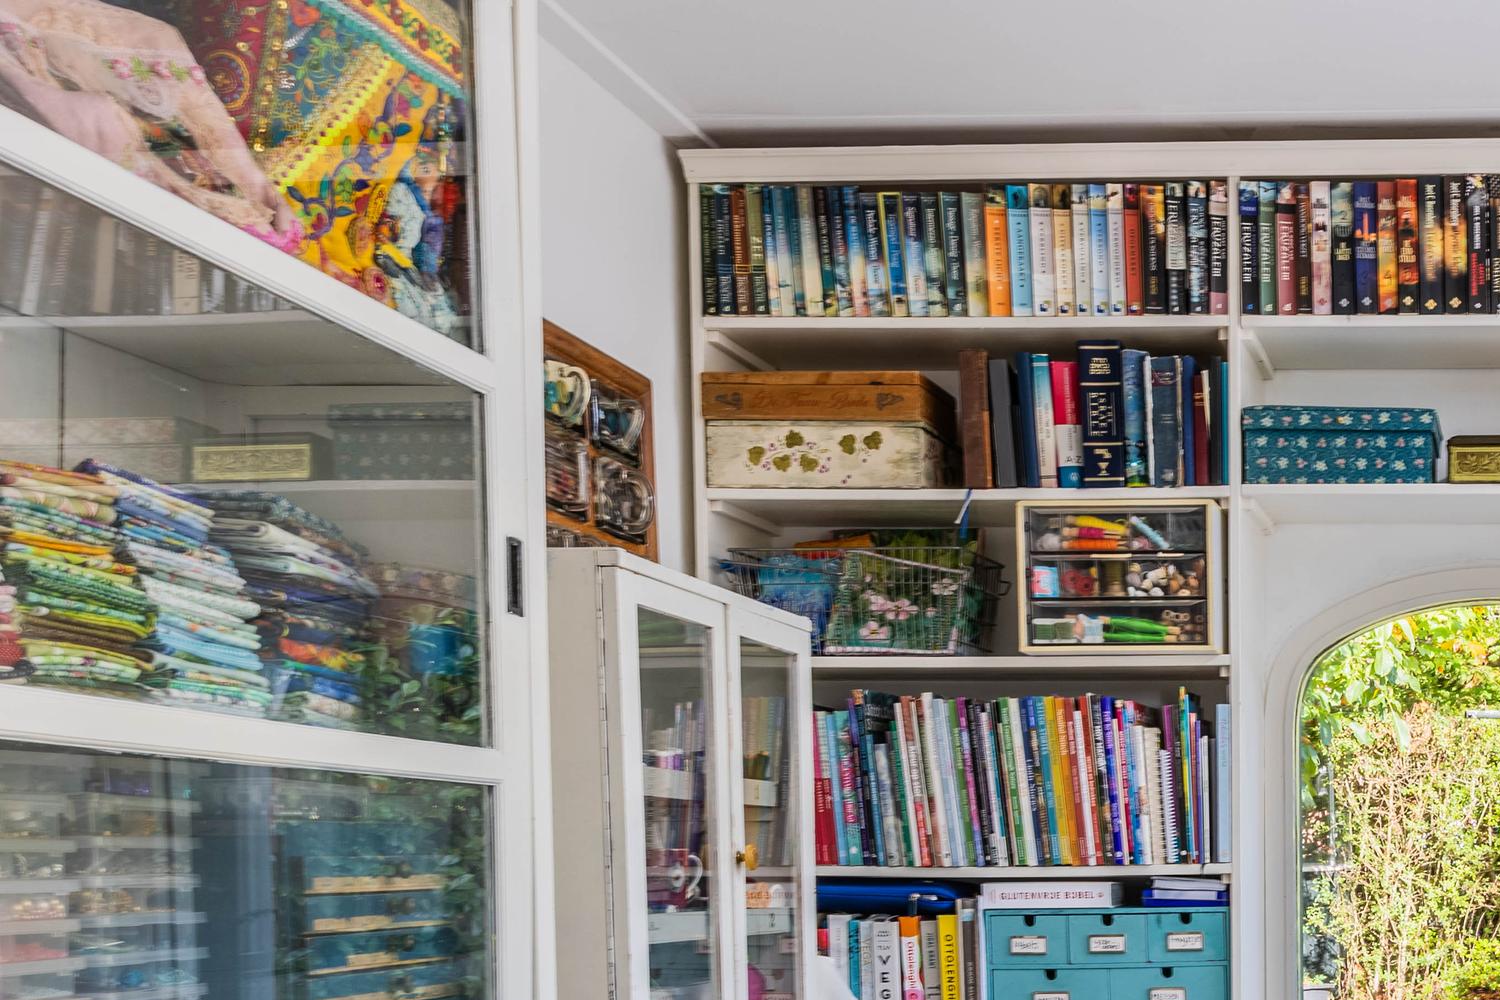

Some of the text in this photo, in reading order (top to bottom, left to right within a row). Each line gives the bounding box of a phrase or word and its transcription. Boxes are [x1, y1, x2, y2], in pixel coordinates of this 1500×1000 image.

[1425, 184, 1436, 195] Joel
[945, 207, 958, 231] Passage
[1424, 201, 1435, 228] Rosenberg
[752, 236, 763, 260] ZEE
[947, 235, 960, 257] Danzig
[1016, 228, 1026, 282] AANGERAAKT
[1211, 217, 1222, 277] JERUZALEM
[1241, 223, 1253, 283] JERUZALEM
[1260, 223, 1272, 283] JERUZALEM
[1279, 221, 1291, 281] JERUZALEM
[1089, 392, 1099, 437] BIBLE
[1098, 392, 1108, 436] ISRAEL
[1103, 711, 1112, 722] Felt
[908, 745, 921, 768] kleur
[862, 937, 872, 967] VEGA
[907, 942, 917, 989] Ottolenghi
